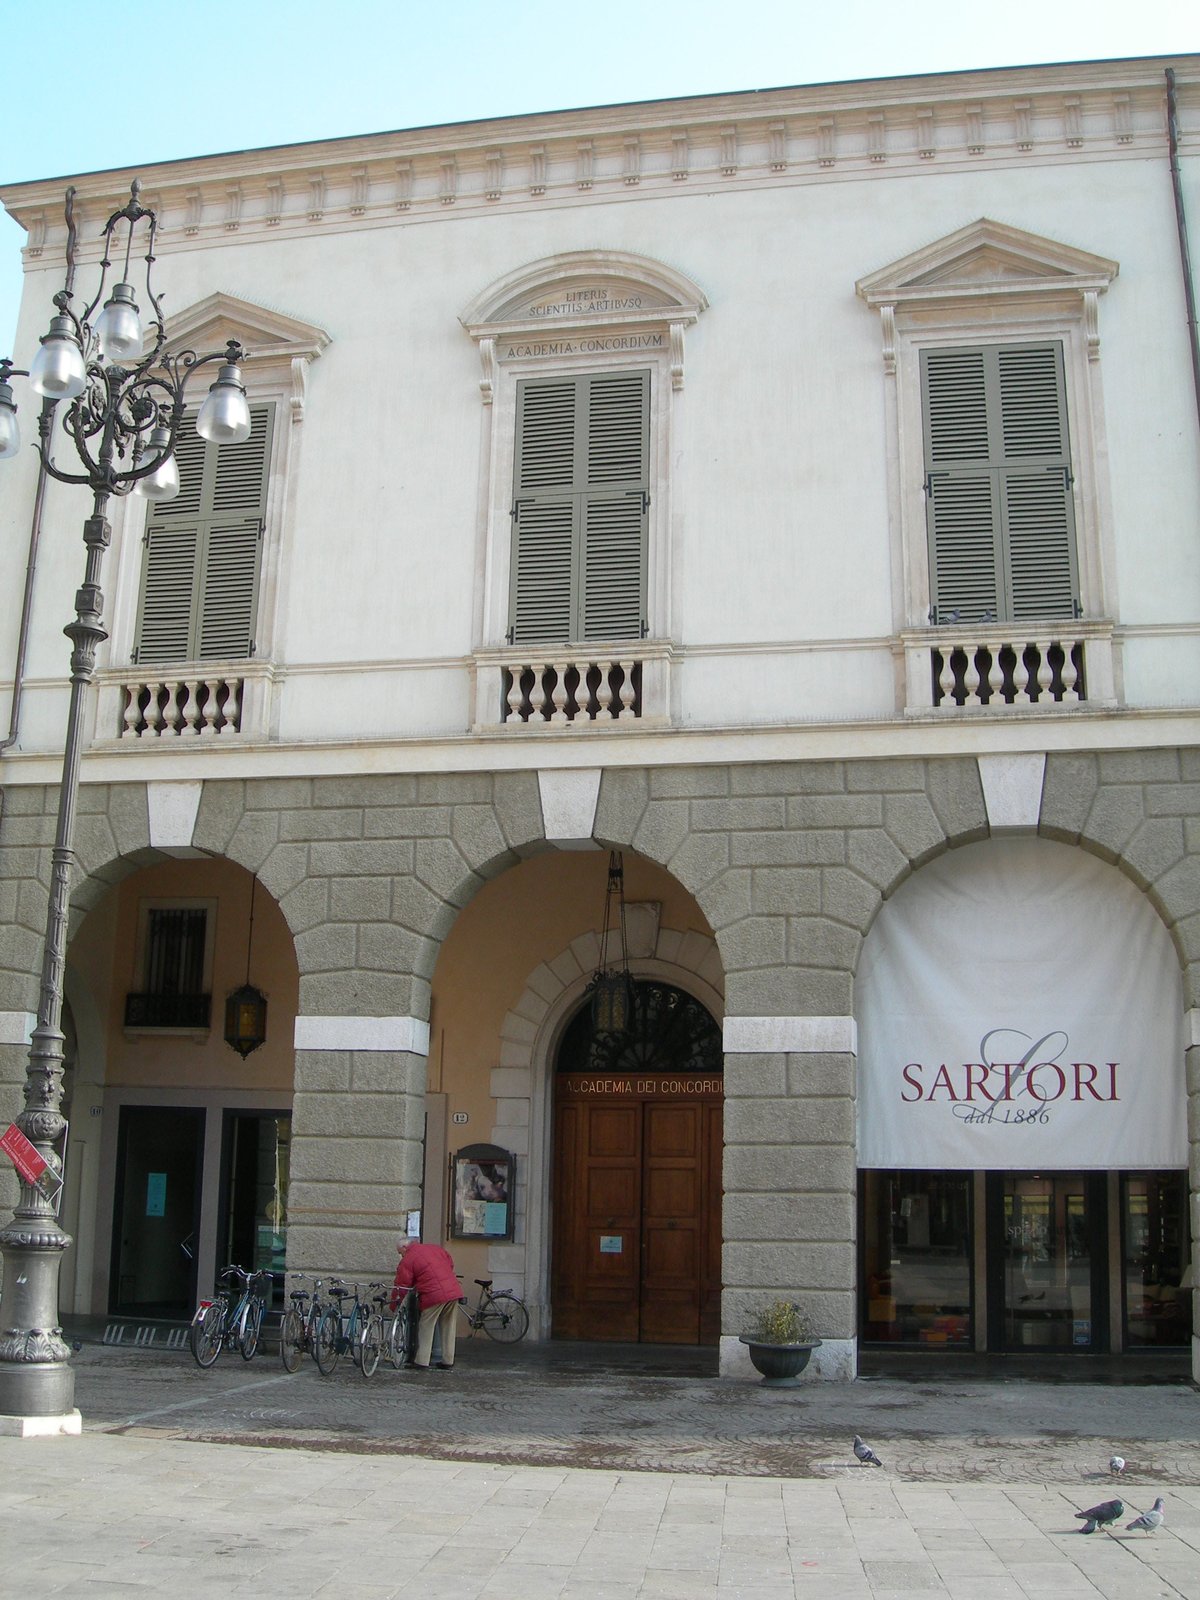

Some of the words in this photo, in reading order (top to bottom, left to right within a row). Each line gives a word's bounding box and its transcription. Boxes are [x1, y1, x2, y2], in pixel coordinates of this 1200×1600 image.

[566, 290, 608, 302] LITERIS
[529, 303, 583, 316] SCIENTIIS
[507, 342, 574, 358] ACADEMIA
[580, 335, 662, 351] CONCORDIVM
[637, 1080, 656, 1093] DEI
[661, 1080, 723, 1093] CONCORDI
[901, 1062, 1121, 1102] SARTORI
[964, 1107, 994, 1124] dal
[1003, 1107, 1052, 1124] 1886
